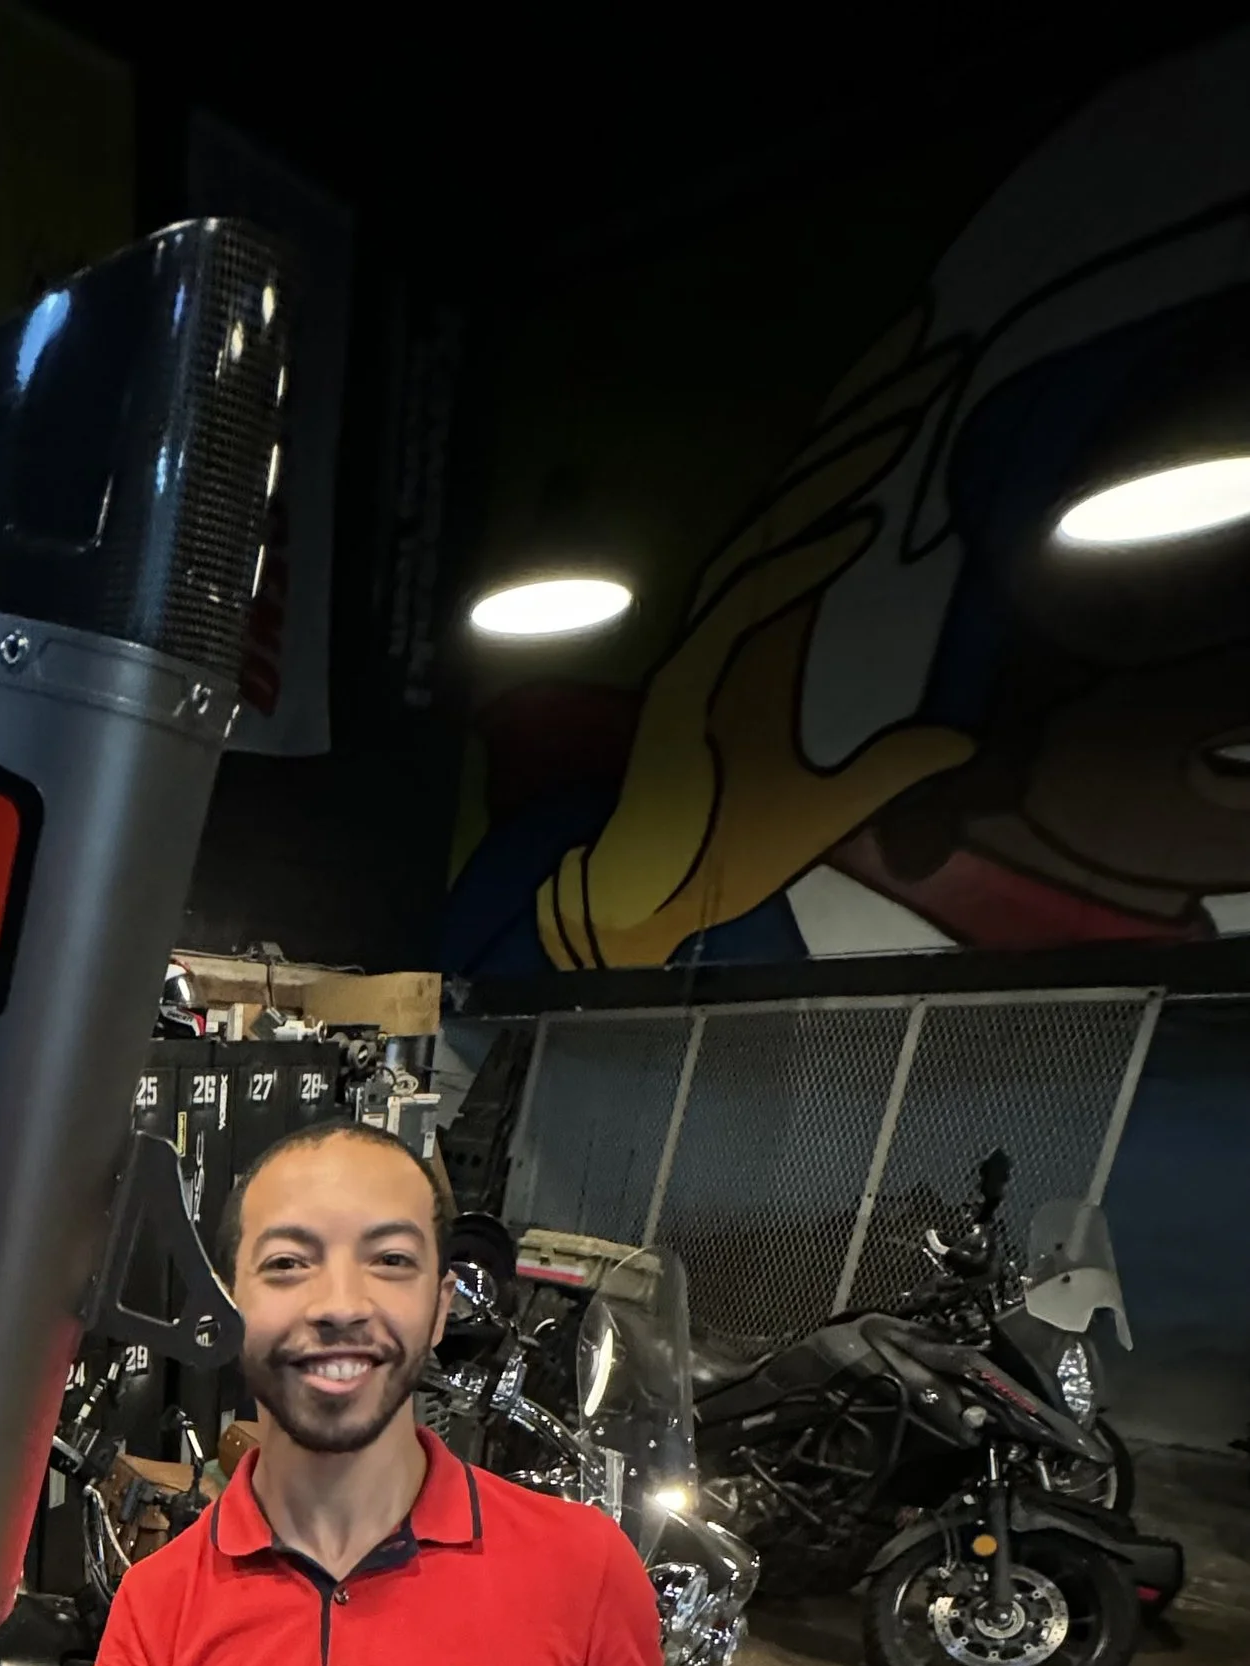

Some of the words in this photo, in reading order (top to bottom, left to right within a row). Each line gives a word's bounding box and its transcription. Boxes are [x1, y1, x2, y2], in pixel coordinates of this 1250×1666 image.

[136, 1075, 158, 1106] 25
[193, 1075, 216, 1104] 26
[253, 1073, 274, 1101] 27
[125, 1346, 149, 1372] 29
